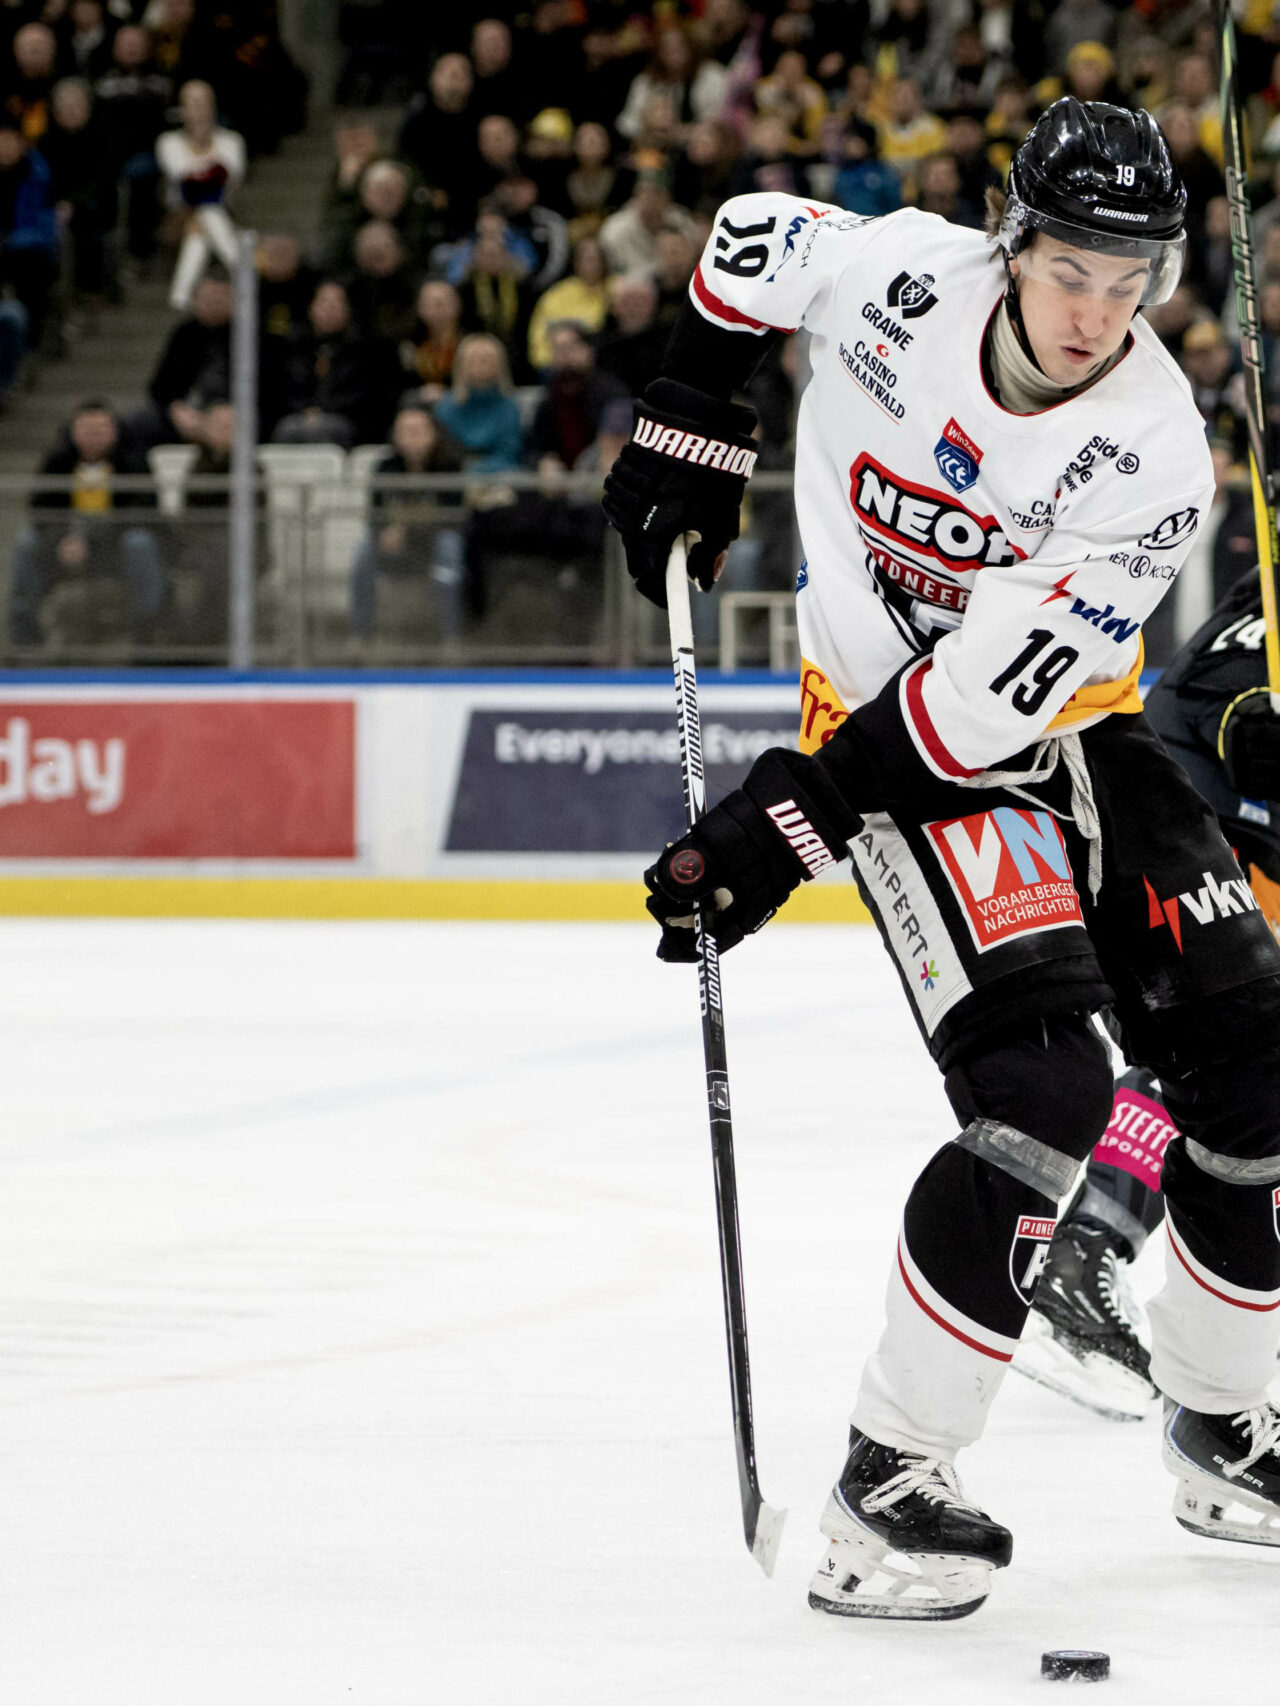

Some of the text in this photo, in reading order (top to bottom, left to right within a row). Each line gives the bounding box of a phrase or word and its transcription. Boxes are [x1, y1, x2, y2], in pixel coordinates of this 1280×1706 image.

[1115, 164, 1136, 188] 19
[1092, 206, 1149, 223] WARRIOR
[861, 302, 914, 351] GRAWE
[838, 342, 906, 419] SCHAANWALD
[854, 340, 898, 389] CASINO
[989, 629, 1079, 717] 19
[682, 668, 704, 781] WARRIOR
[941, 806, 1071, 903] VN
[977, 882, 1078, 917] VORARLBERGER
[983, 897, 1076, 933] NACHRICHTEN
[1178, 871, 1261, 925] vkw
[704, 932, 722, 1009] NOVIUM
